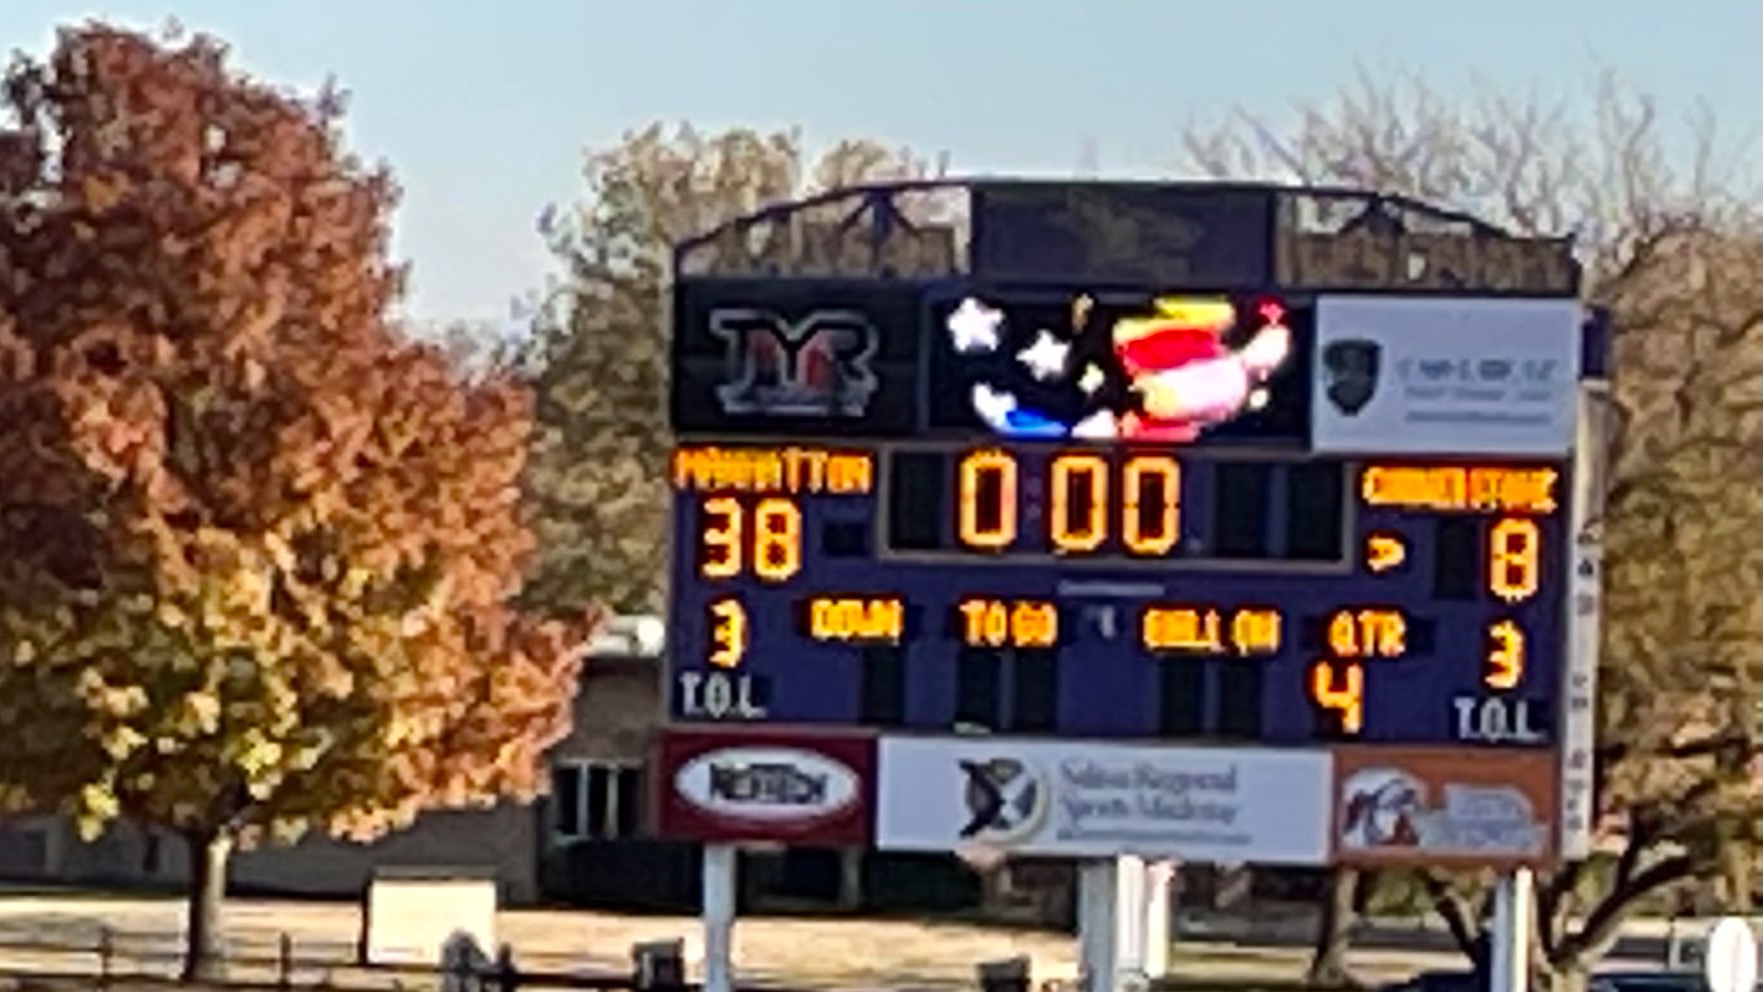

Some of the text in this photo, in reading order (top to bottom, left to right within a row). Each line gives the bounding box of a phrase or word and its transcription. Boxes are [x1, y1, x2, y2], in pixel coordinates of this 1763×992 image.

[702, 496, 802, 580] 38
[1490, 517, 1538, 602] 8
[709, 598, 748, 668] 3
[809, 598, 905, 644] DOWN
[1329, 610, 1406, 657] QTR
[1485, 619, 1526, 689] 3
[1314, 661, 1363, 734] 4
